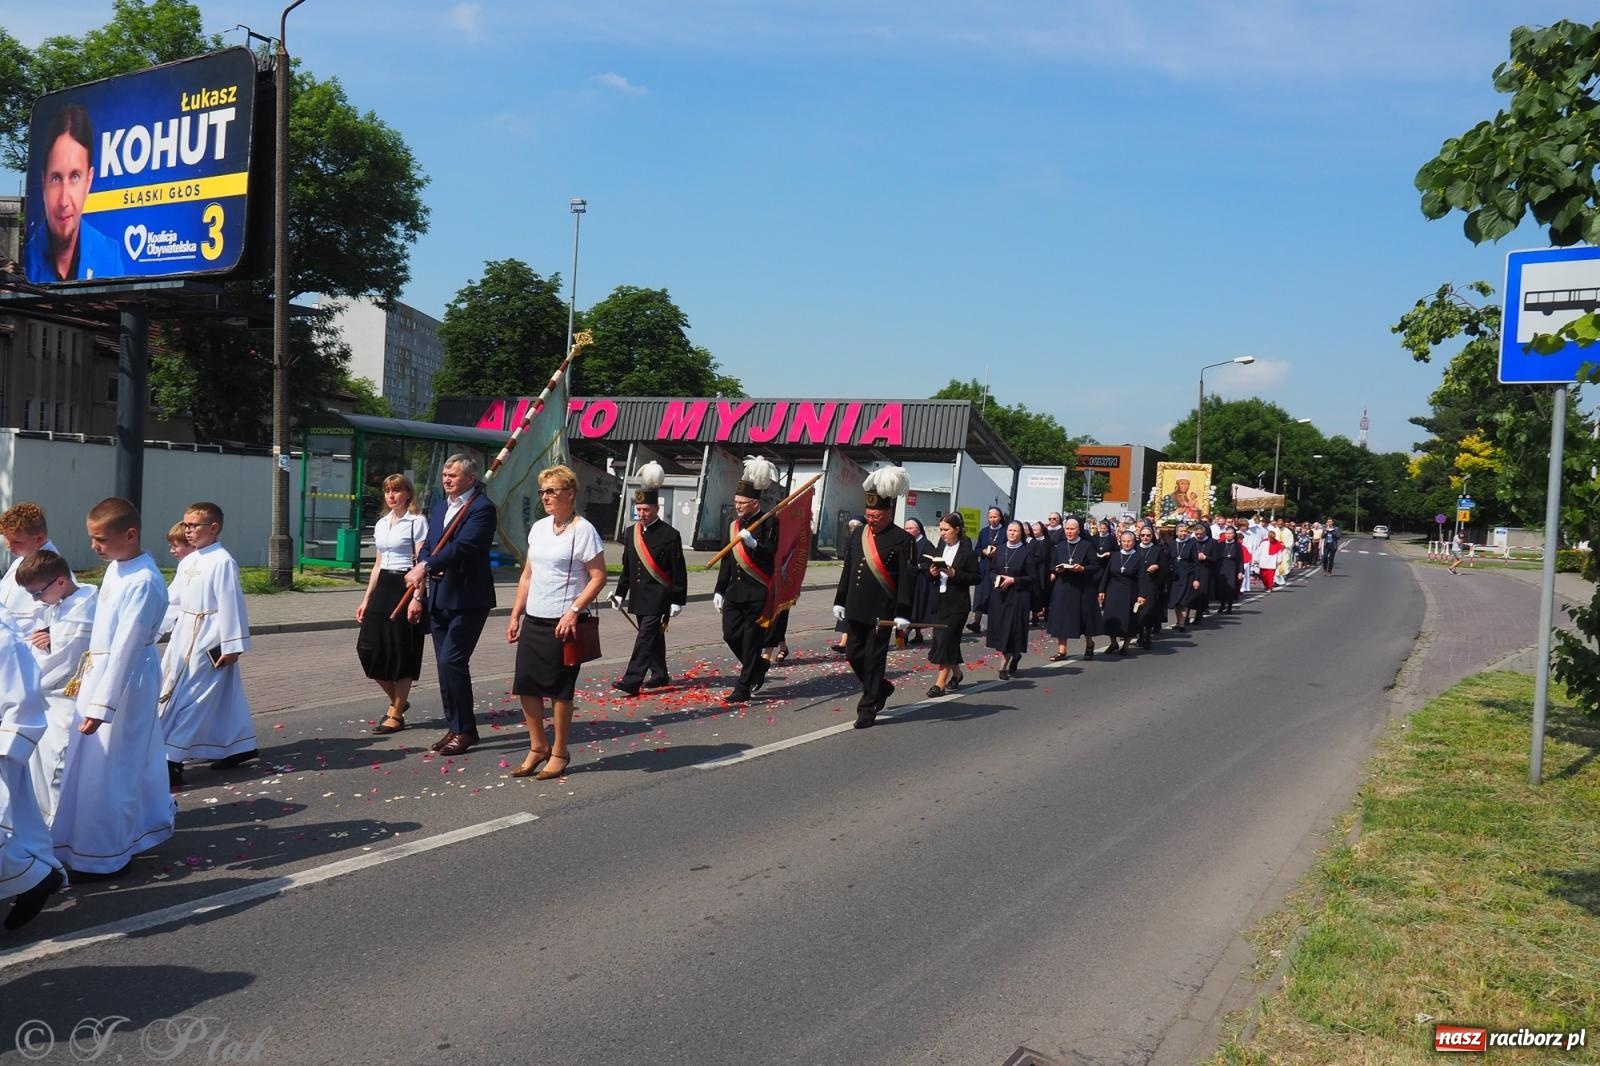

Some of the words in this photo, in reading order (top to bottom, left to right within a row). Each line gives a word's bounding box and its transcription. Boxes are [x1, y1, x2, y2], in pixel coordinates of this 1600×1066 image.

[181, 86, 238, 112] Łukasz
[99, 107, 236, 178] KOHUT
[123, 189, 163, 205] ŚLĄSKI
[169, 184, 201, 199] GŁOS
[147, 230, 178, 244] Koalicja
[201, 202, 225, 261] 3
[146, 240, 197, 257] Obywatelska
[657, 400, 903, 445] MYJNIA
